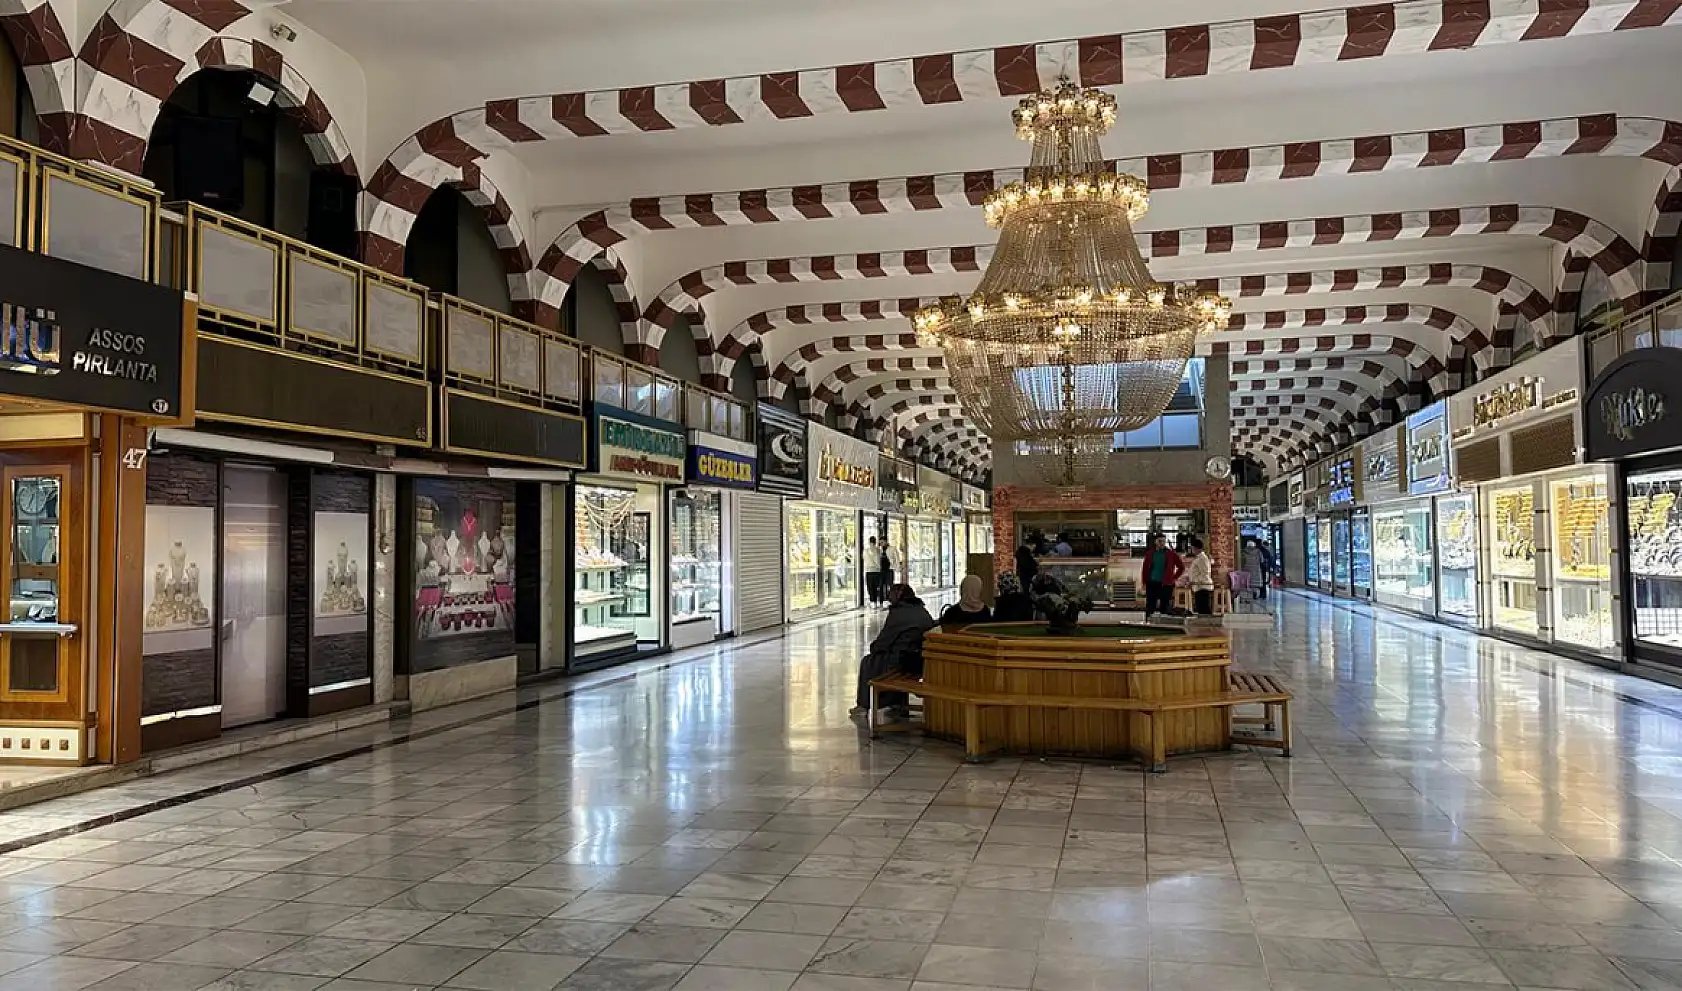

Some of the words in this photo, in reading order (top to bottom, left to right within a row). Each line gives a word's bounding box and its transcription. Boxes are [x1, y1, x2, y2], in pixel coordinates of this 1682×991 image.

[89, 327, 146, 355] ASSOS
[73, 350, 157, 383] PIRLANTA
[122, 447, 147, 469] 47
